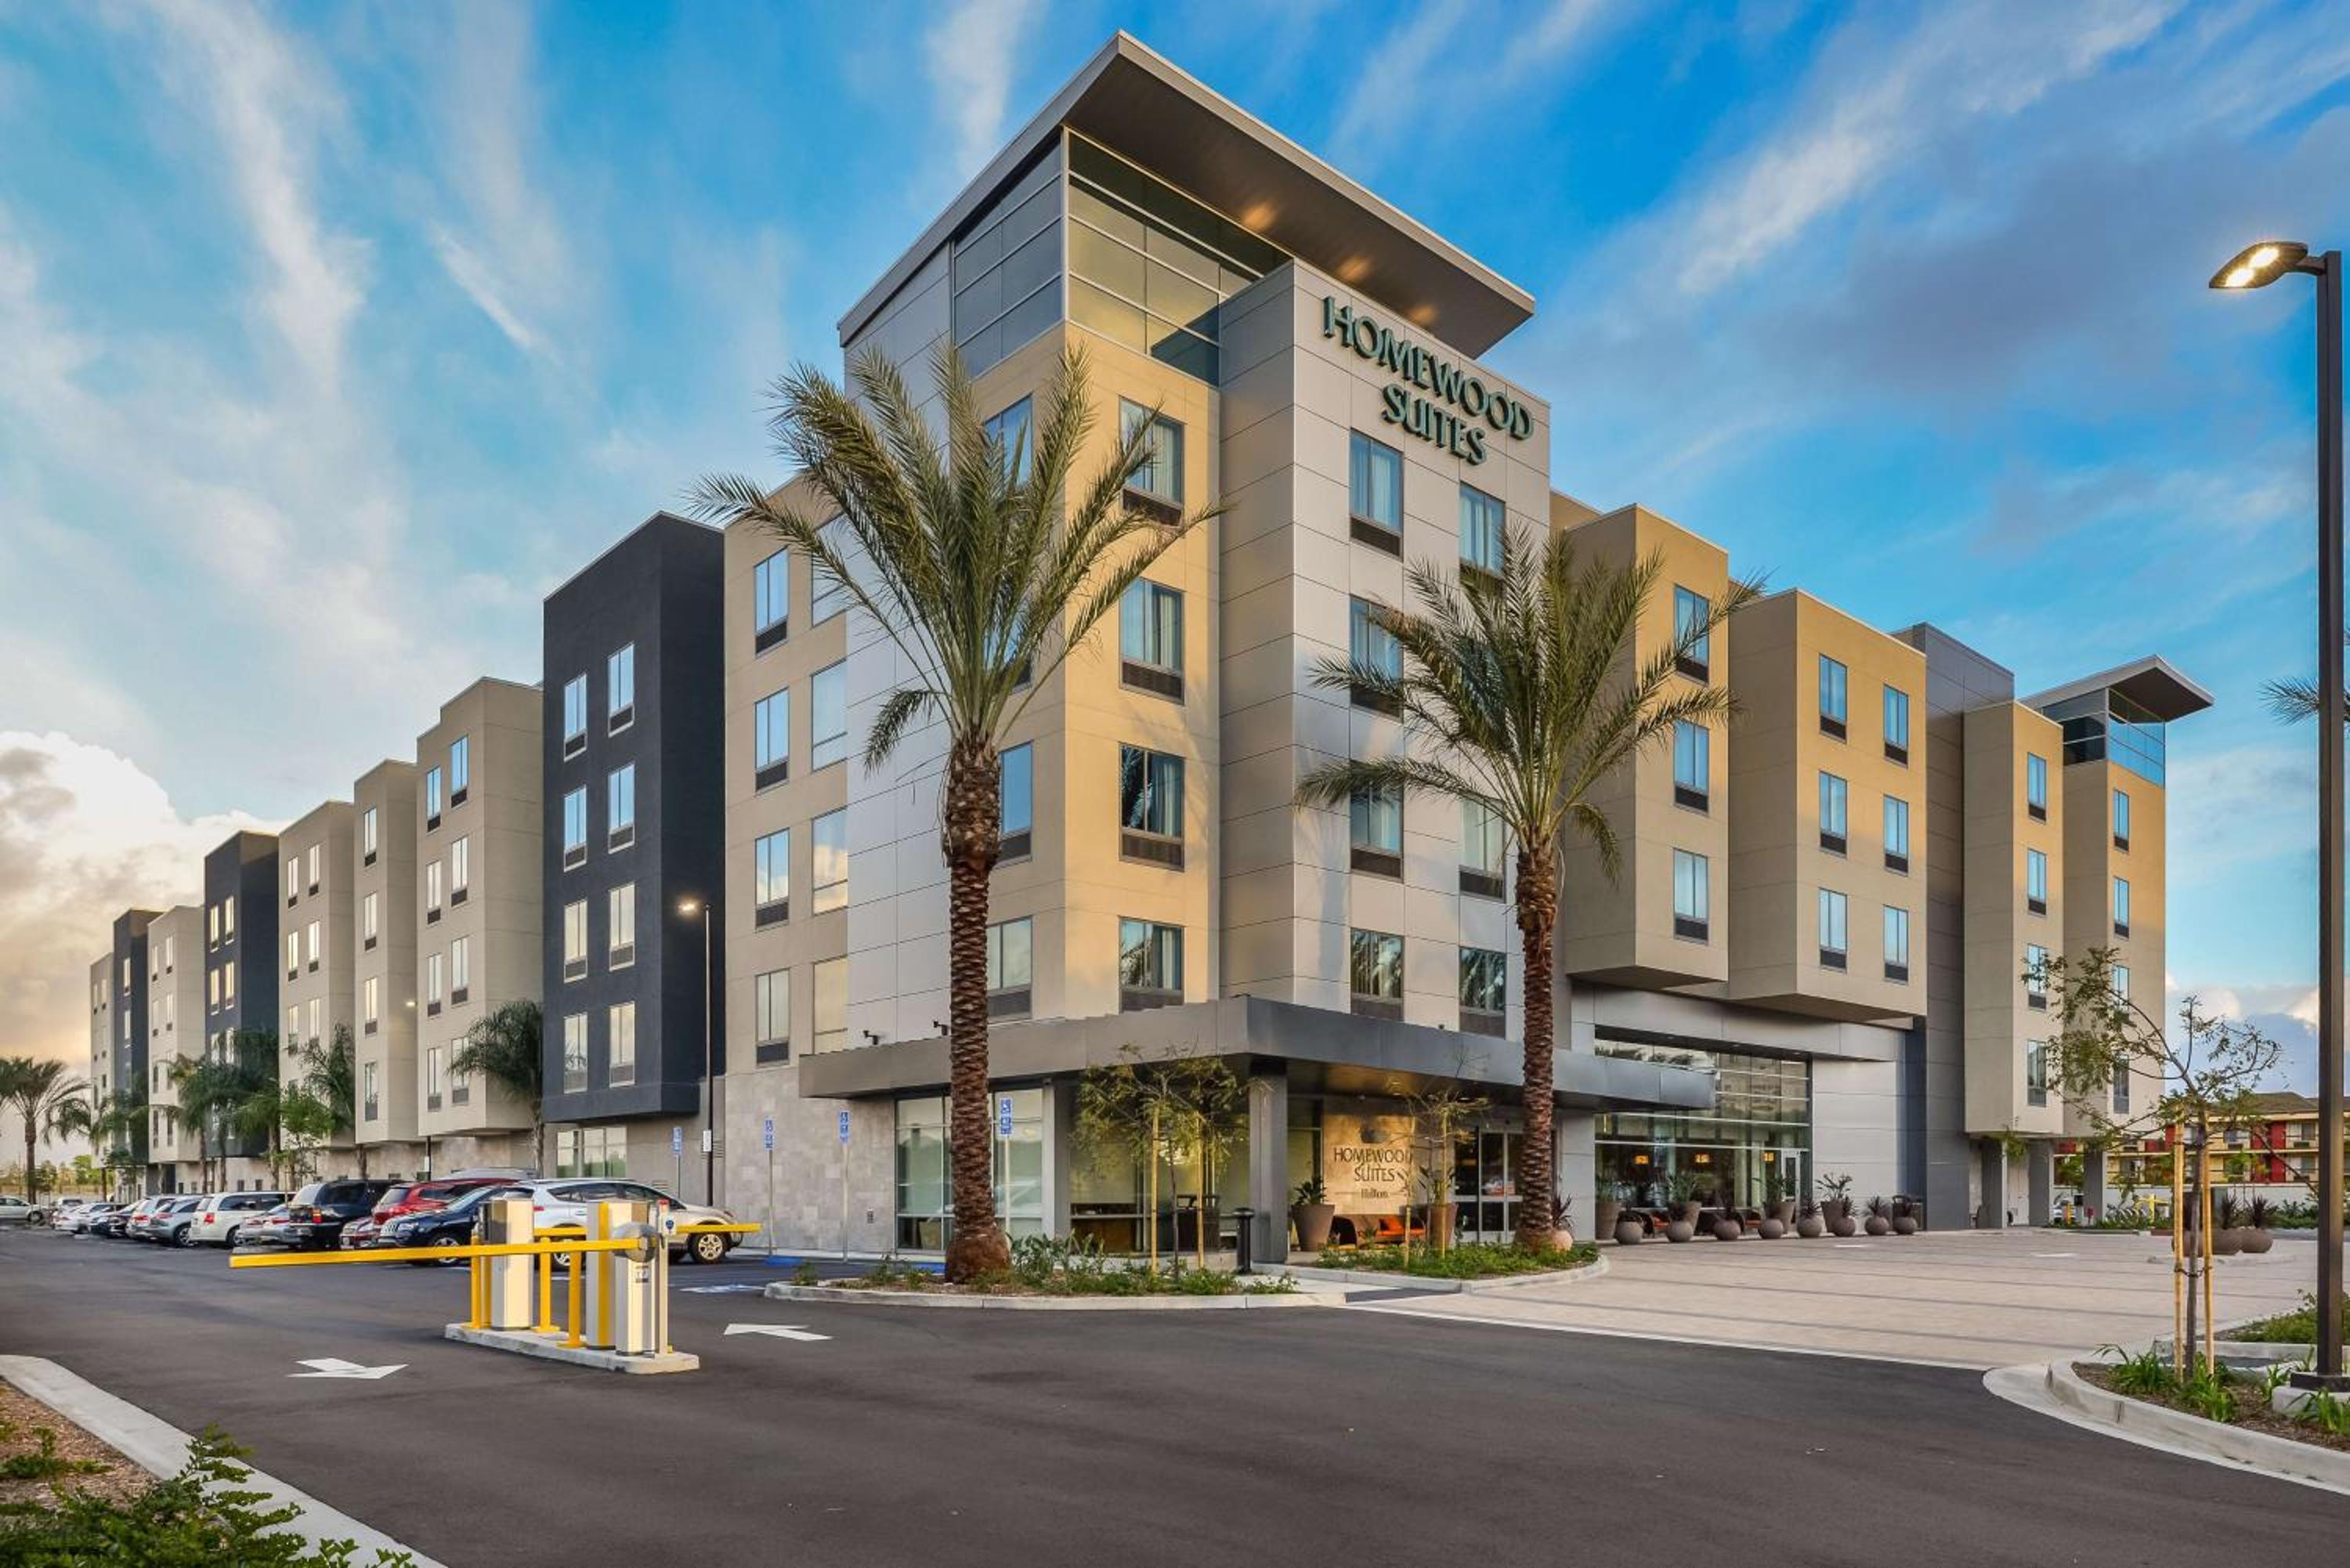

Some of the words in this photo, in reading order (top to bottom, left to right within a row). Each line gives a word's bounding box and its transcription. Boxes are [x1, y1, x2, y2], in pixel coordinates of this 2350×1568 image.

[1324, 295, 1534, 440] HOMEWOOD
[1382, 384, 1487, 465] SUITES
[1354, 1165, 1394, 1181] SUITES
